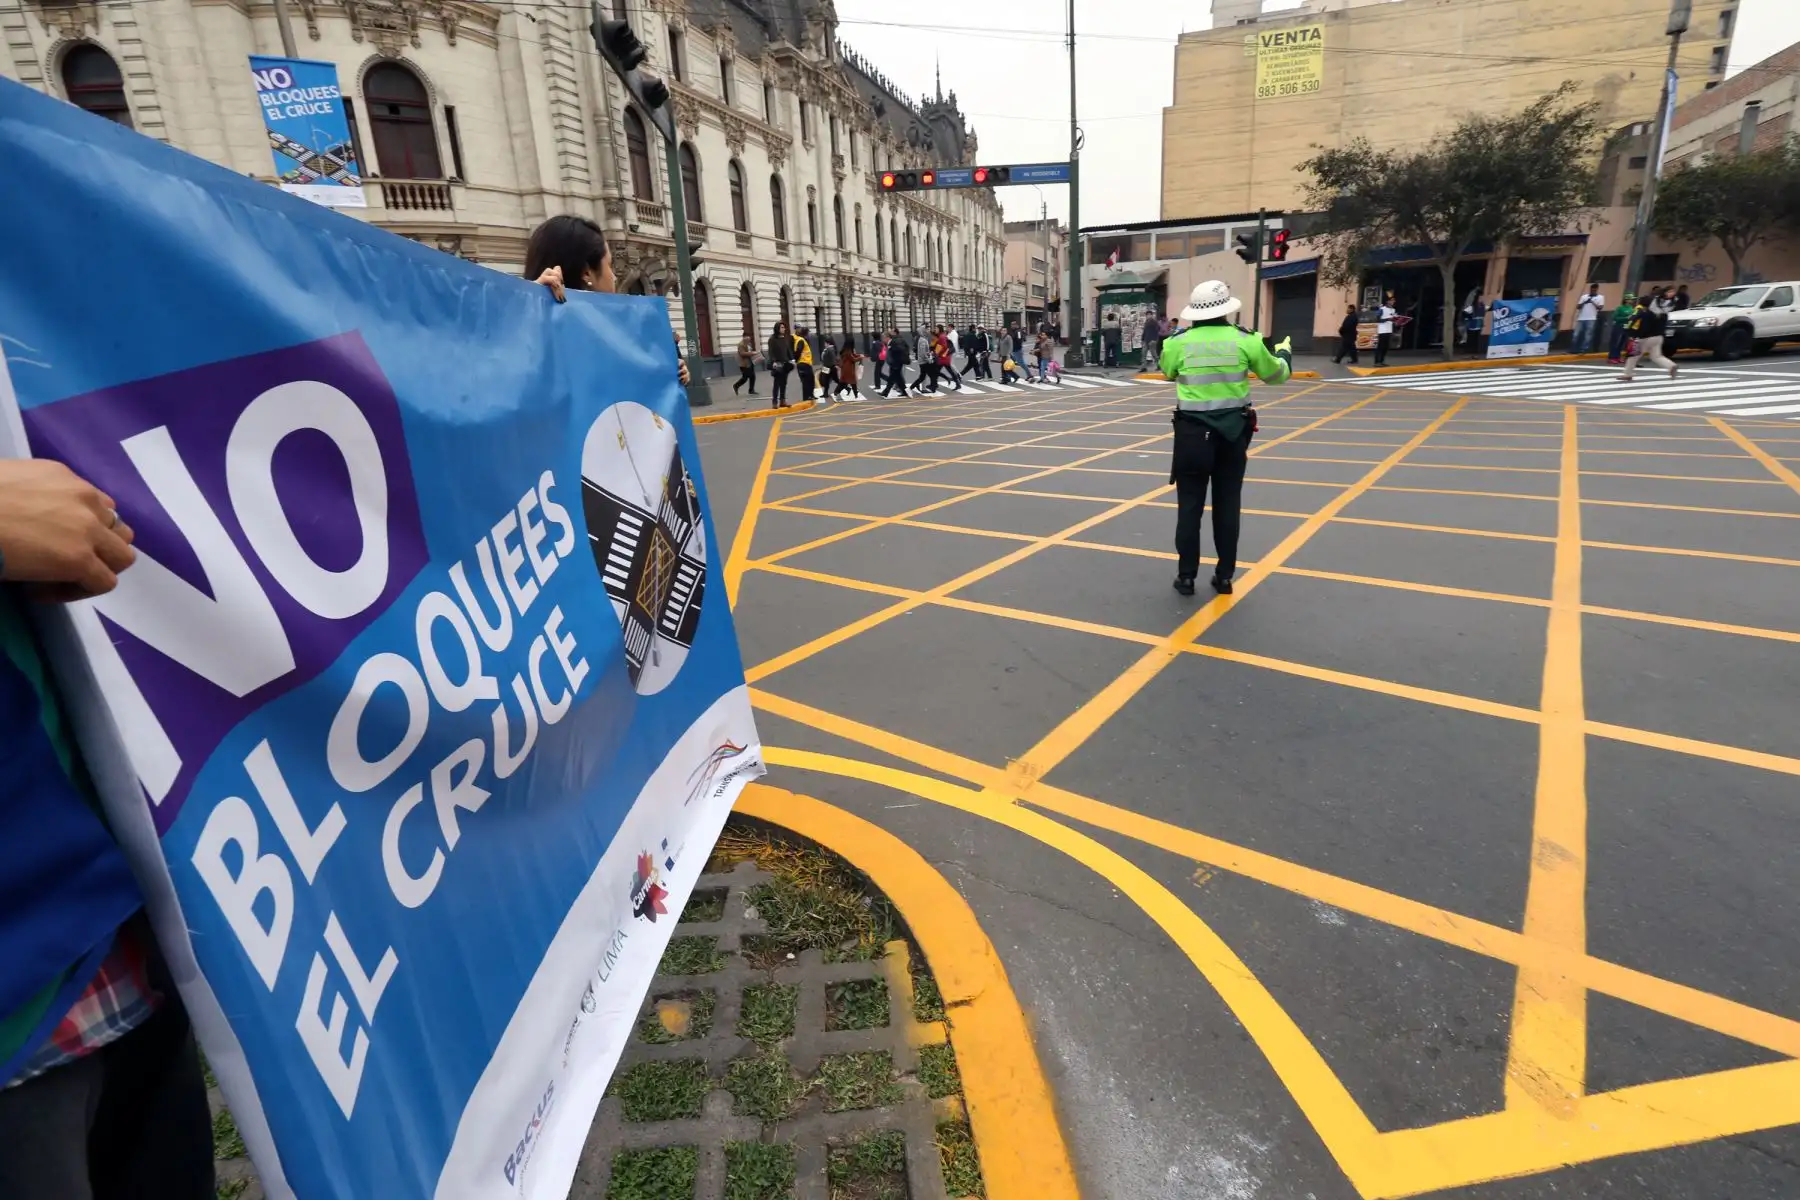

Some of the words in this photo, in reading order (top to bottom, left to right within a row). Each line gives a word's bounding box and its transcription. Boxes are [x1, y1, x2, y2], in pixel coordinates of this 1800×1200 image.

[1261, 27, 1322, 48] VENTA
[251, 67, 293, 92] NO
[1258, 85, 1276, 98] 983
[1279, 82, 1298, 95] 506
[1302, 79, 1320, 92] 530
[259, 86, 340, 107] BLOQUEES
[266, 108, 286, 121] EL
[286, 102, 333, 119] CRUCE
[1493, 306, 1510, 320] NO
[65, 380, 389, 807] NO
[191, 470, 575, 993] BLOQUEES
[295, 910, 400, 1121] EL
[381, 604, 590, 908] CRUCE
[597, 929, 629, 983] LIMA
